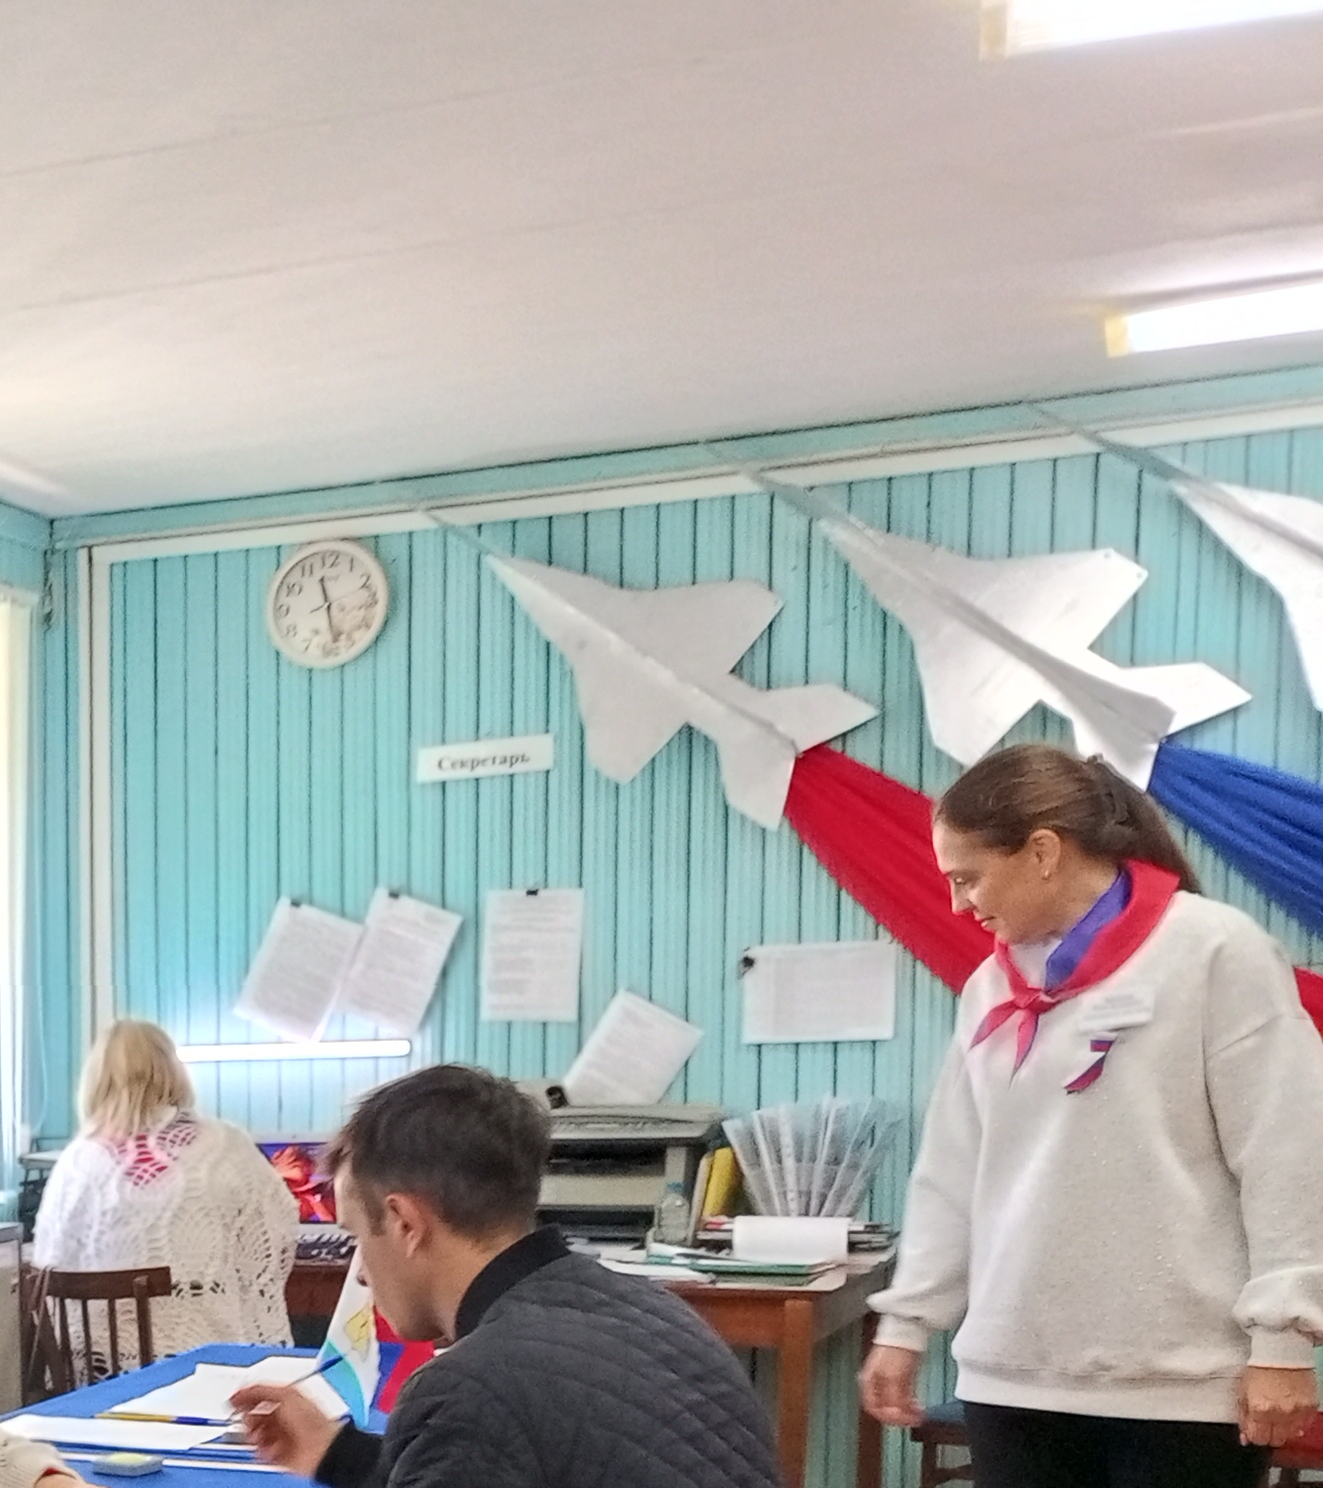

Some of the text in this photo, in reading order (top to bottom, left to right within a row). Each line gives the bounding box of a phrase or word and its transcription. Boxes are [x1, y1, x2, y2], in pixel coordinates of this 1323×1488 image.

[321, 551, 340, 568] 12
[301, 563, 314, 578] 11
[286, 582, 304, 598] 10
[359, 573, 373, 591] 2
[437, 752, 530, 772] Секретарь
